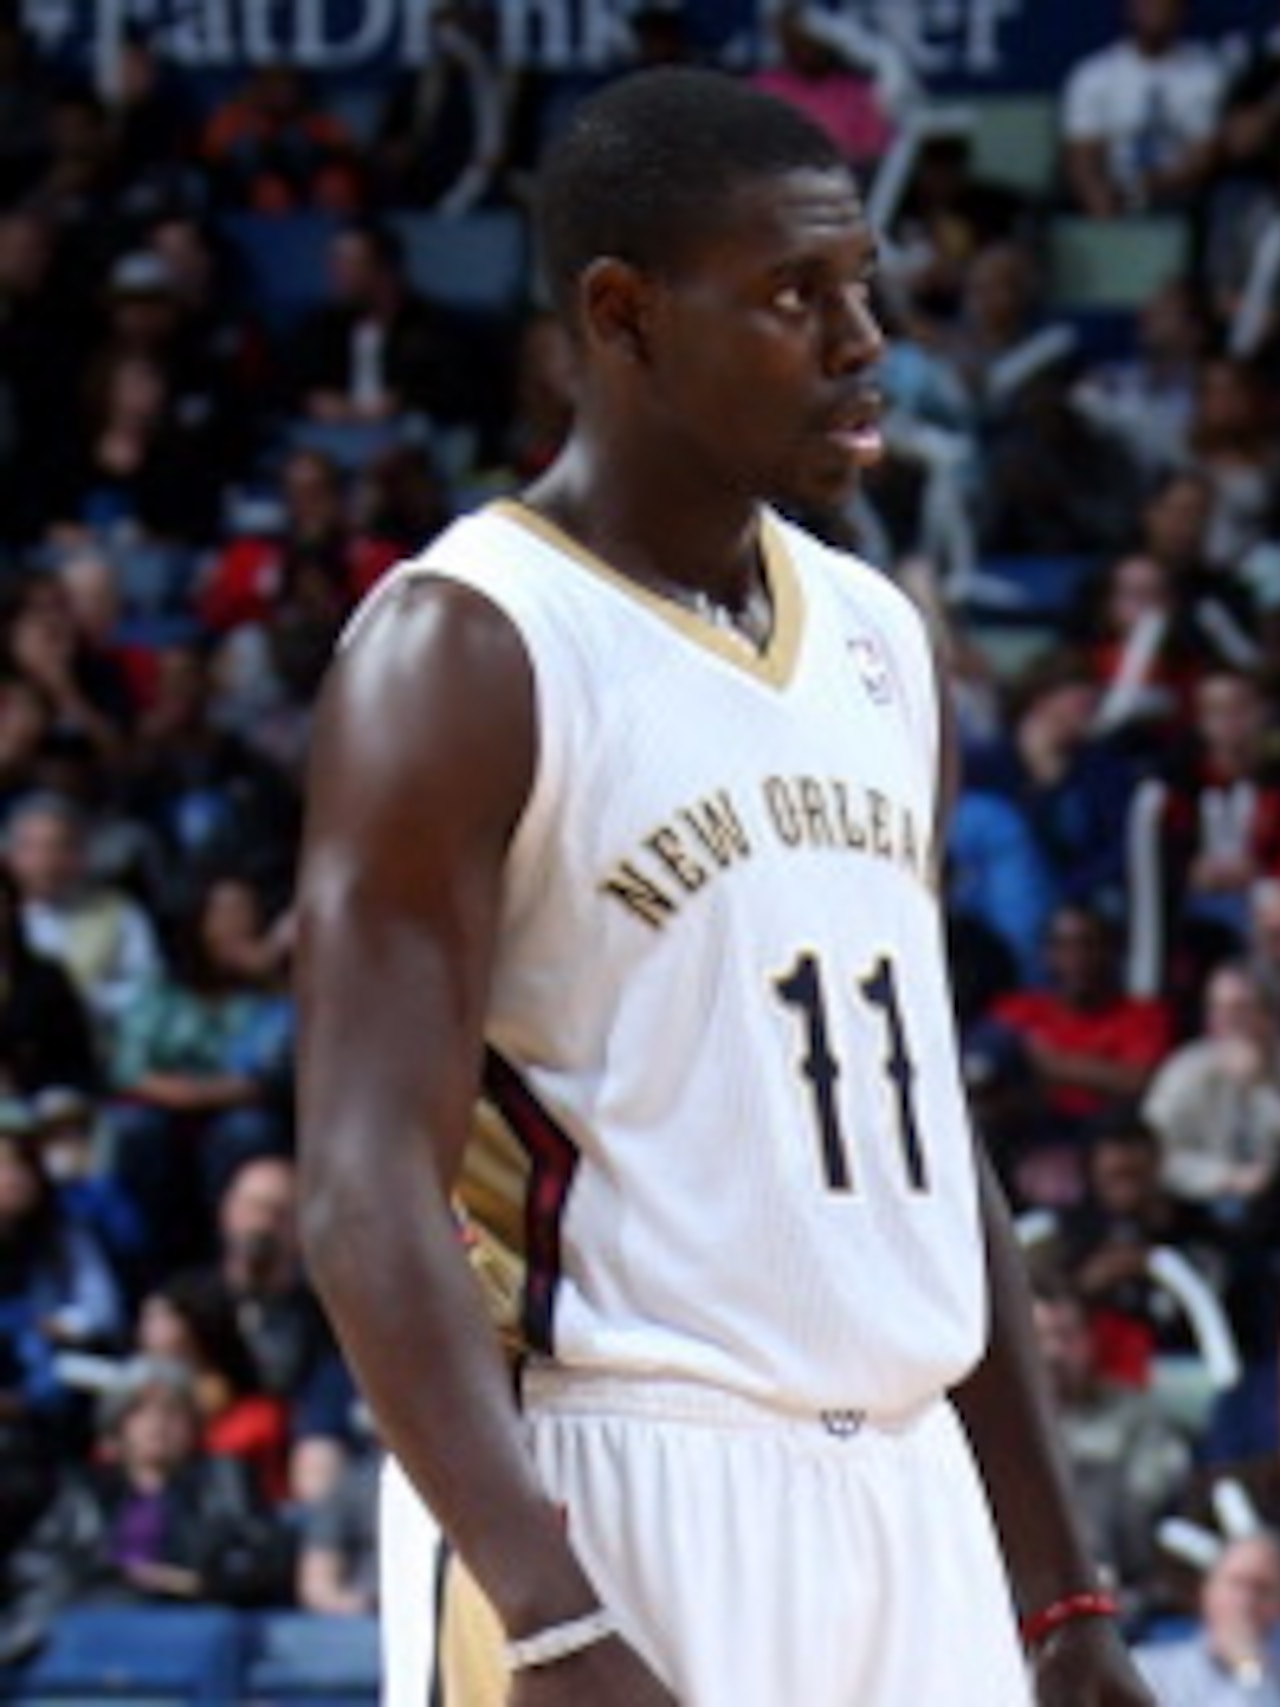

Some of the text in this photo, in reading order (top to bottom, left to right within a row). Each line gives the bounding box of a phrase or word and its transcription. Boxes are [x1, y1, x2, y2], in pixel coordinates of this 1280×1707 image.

[598, 774, 940, 932] NEW ORLEA
[768, 947, 930, 1196] 11
